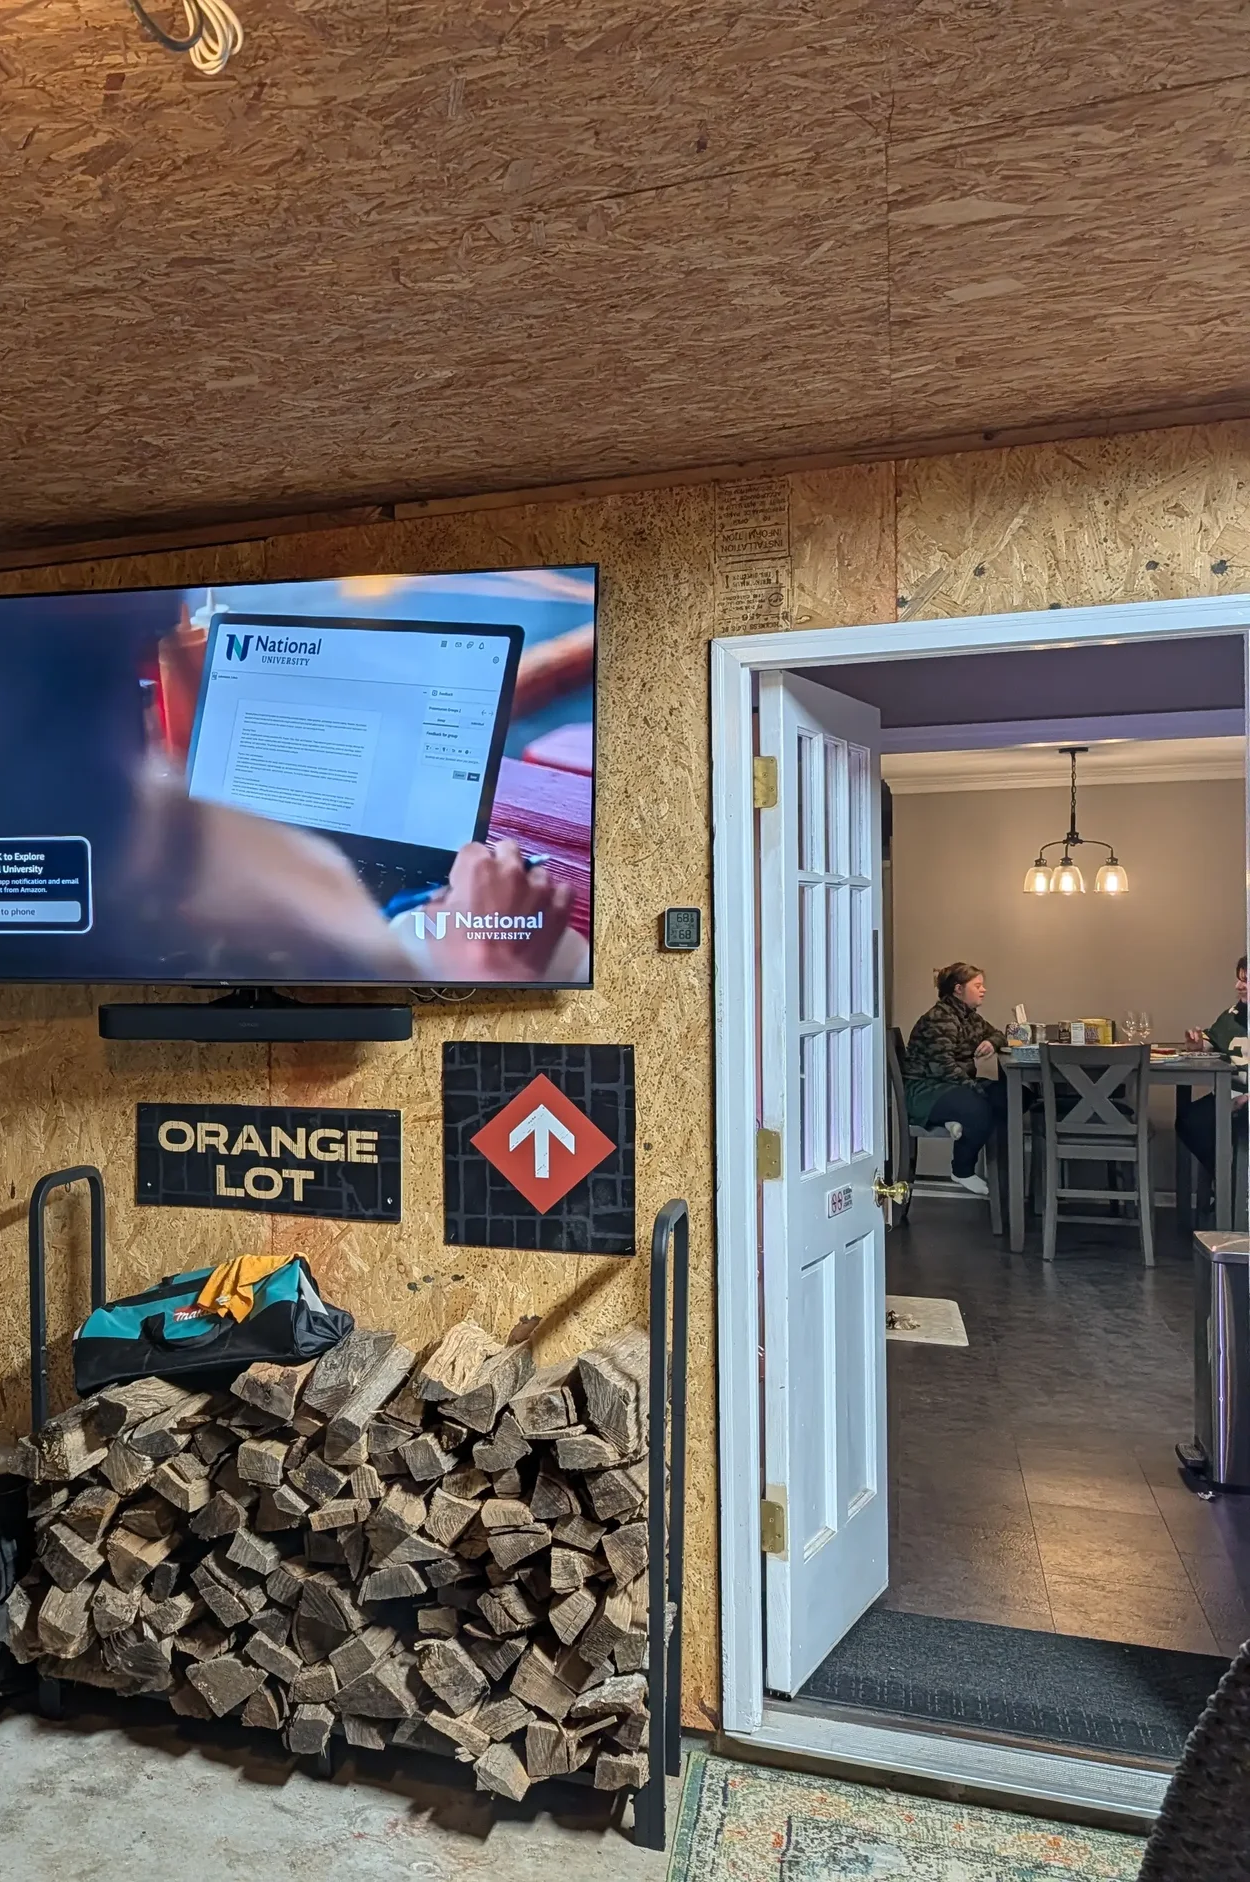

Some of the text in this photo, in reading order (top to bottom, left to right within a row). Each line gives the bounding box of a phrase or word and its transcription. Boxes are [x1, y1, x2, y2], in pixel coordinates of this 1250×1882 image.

[721, 539, 783, 554] INSTALLATION
[255, 635, 322, 655] National
[261, 655, 311, 667] UNIVERSITY
[3, 853, 12, 861] to
[14, 852, 45, 863] Explore
[3, 864, 43, 875] University
[11, 877, 47, 885] notification
[48, 877, 60, 885] and
[61, 877, 79, 885] email
[20, 886, 47, 894] Amazon.
[1, 908, 9, 916] to
[11, 907, 36, 917] phone
[676, 912, 689, 923] 68
[455, 911, 543, 929] National
[466, 932, 531, 940] UNIVERSITY
[678, 929, 692, 940] 68
[157, 1119, 379, 1164] ORANGE
[215, 1163, 315, 1201] LOT
